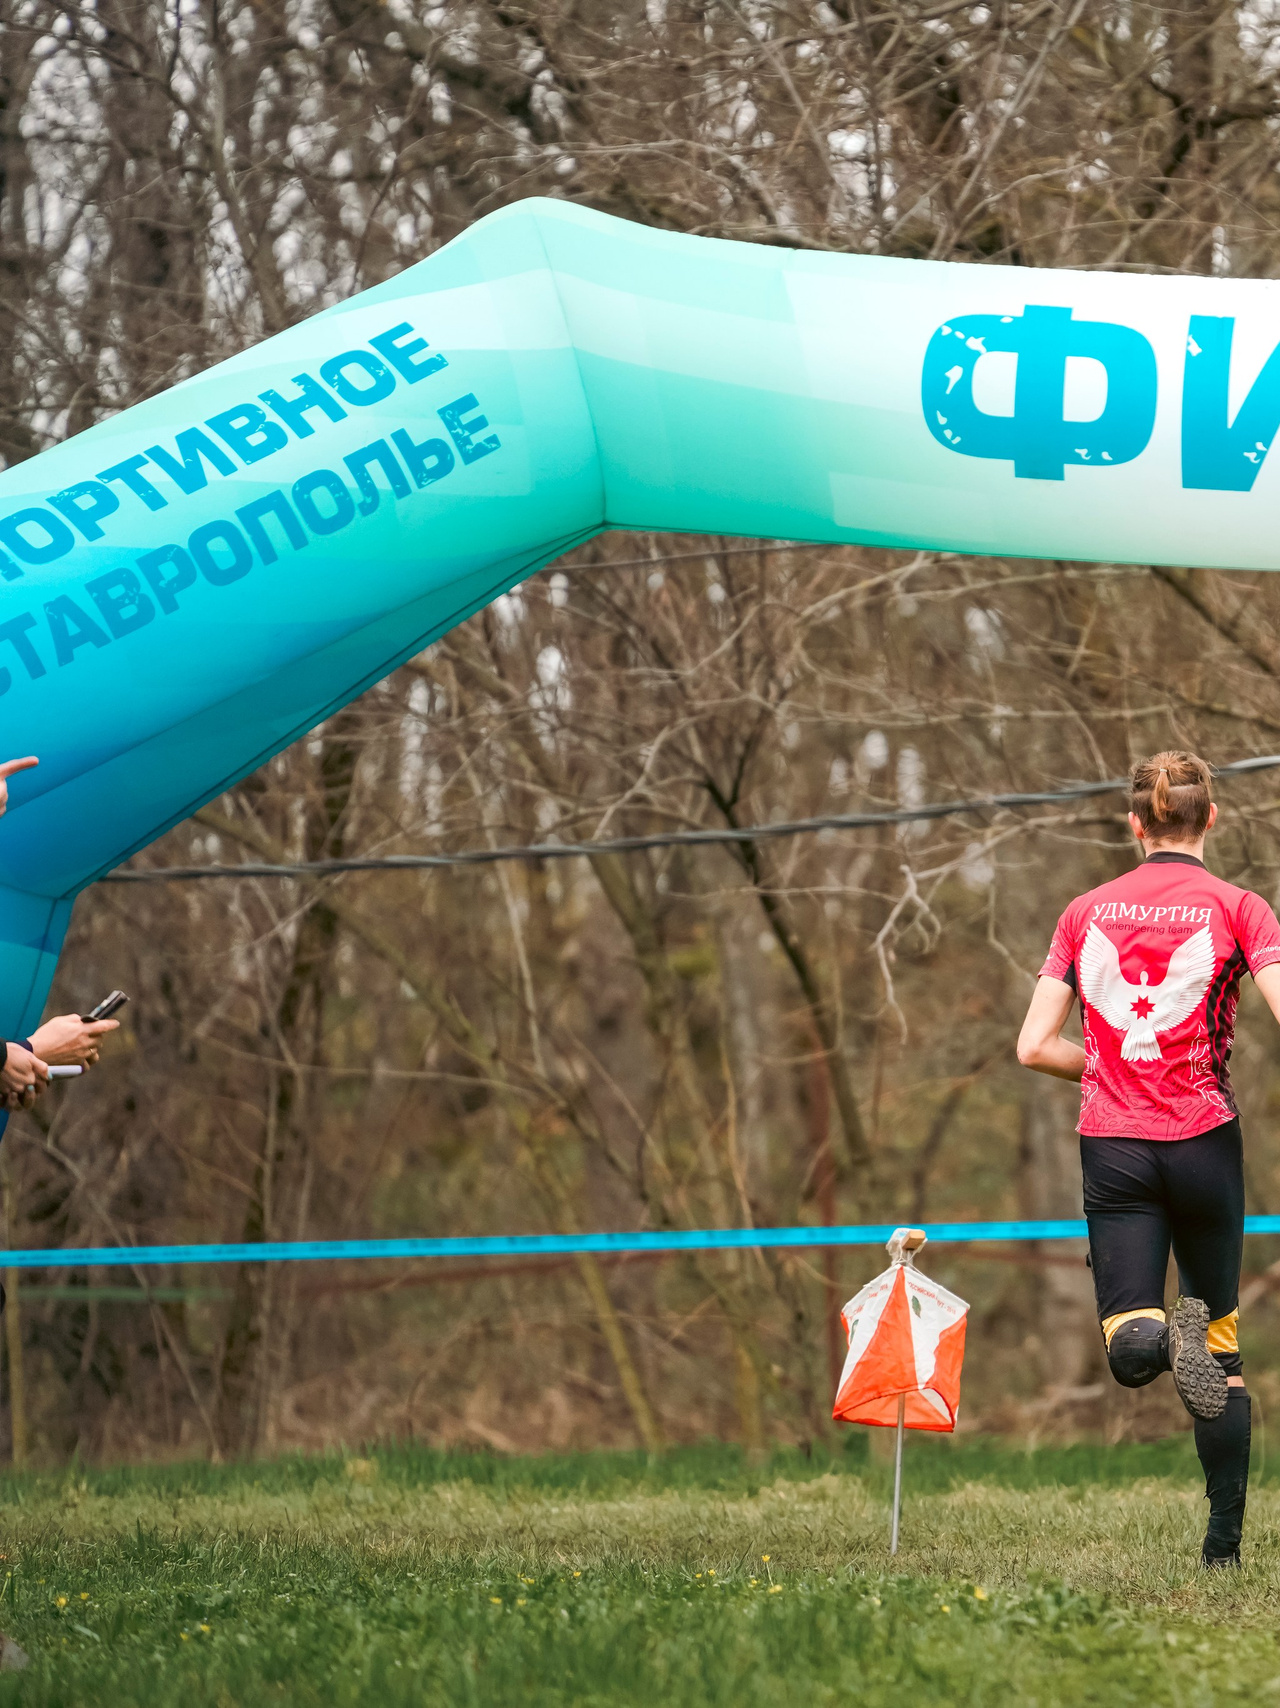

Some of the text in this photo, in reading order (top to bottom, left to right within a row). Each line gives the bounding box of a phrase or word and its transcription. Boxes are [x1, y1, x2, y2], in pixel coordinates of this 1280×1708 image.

[0, 393, 500, 697] ТАВРОПОЛЬЕ
[1092, 902, 1213, 924] УДМУРТИЯ
[1105, 921, 1193, 935] orienteering team
